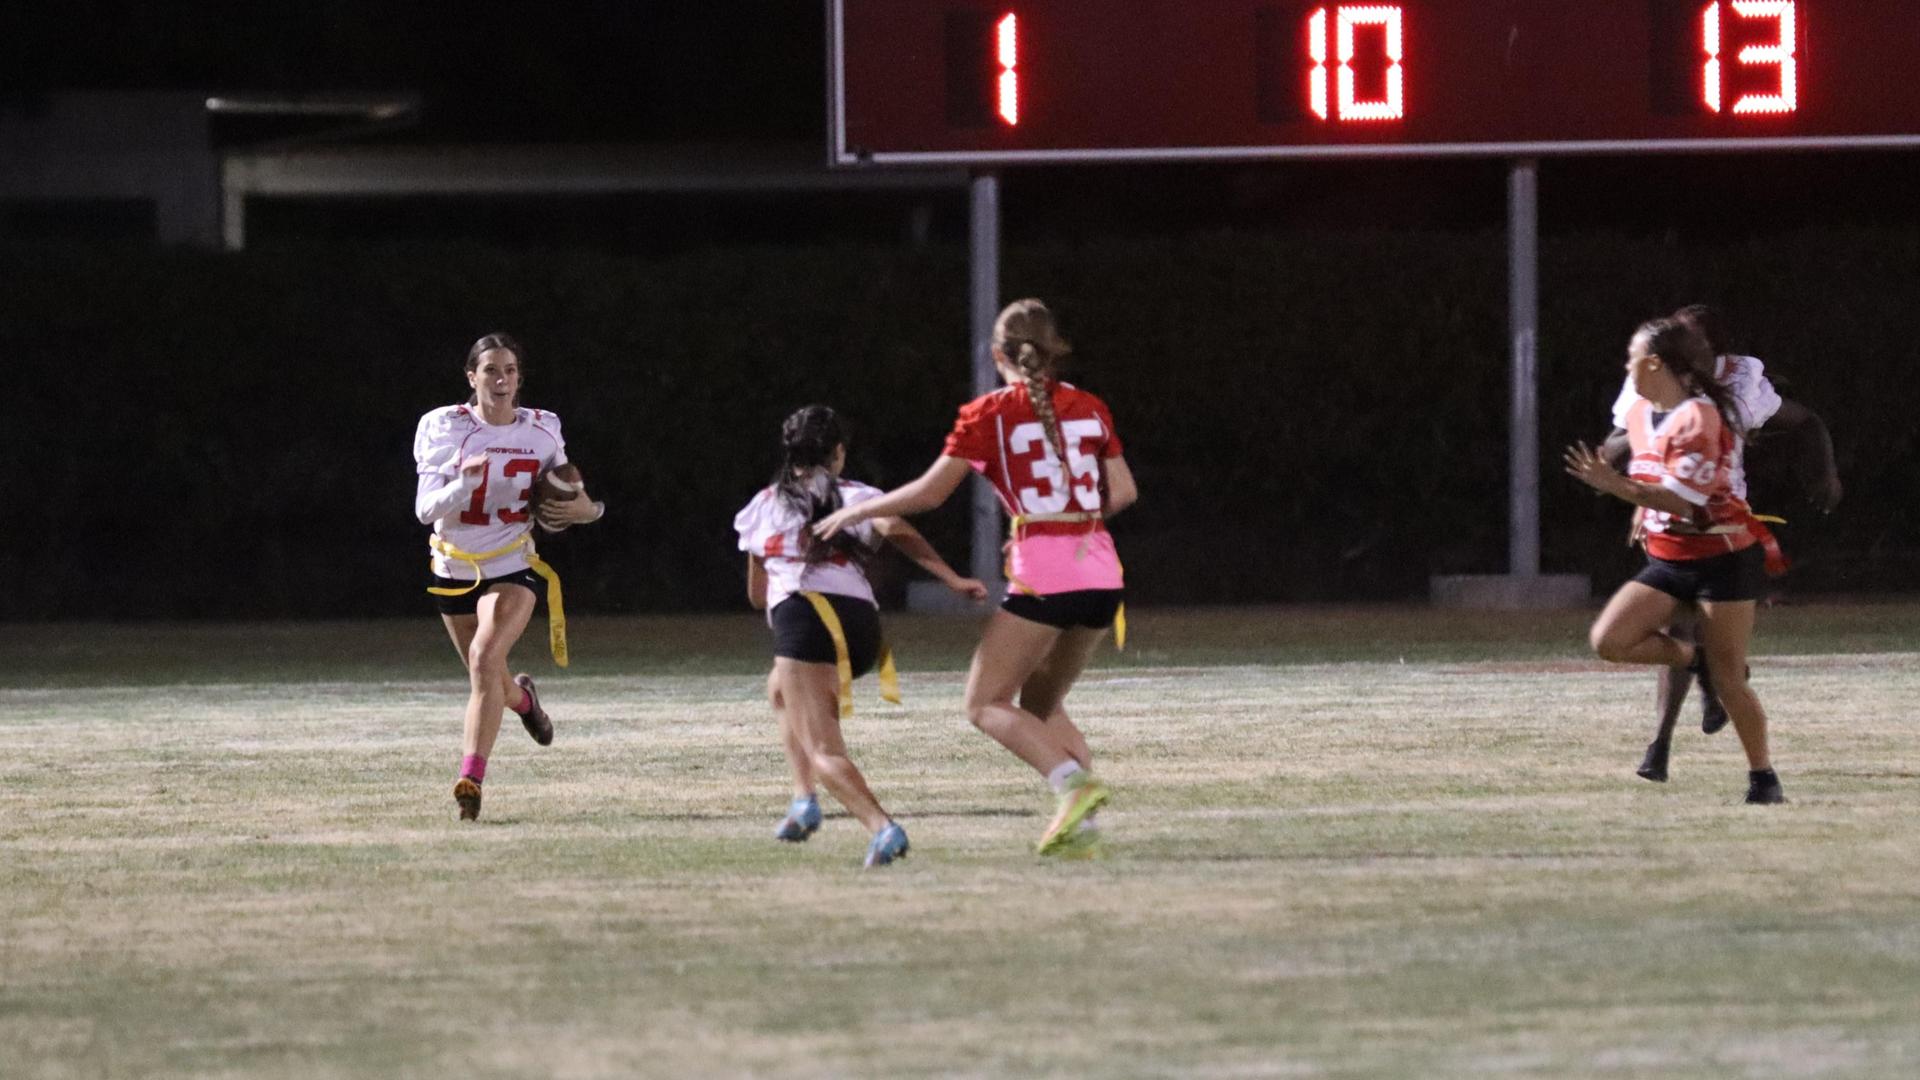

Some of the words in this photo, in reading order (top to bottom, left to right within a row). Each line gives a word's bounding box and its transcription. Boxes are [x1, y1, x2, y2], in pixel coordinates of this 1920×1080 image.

[995, 12, 1019, 125] 1
[1309, 5, 1403, 121] 10
[1703, 0, 1797, 113] 13
[461, 458, 540, 526] 13
[1010, 419, 1103, 514] 35
